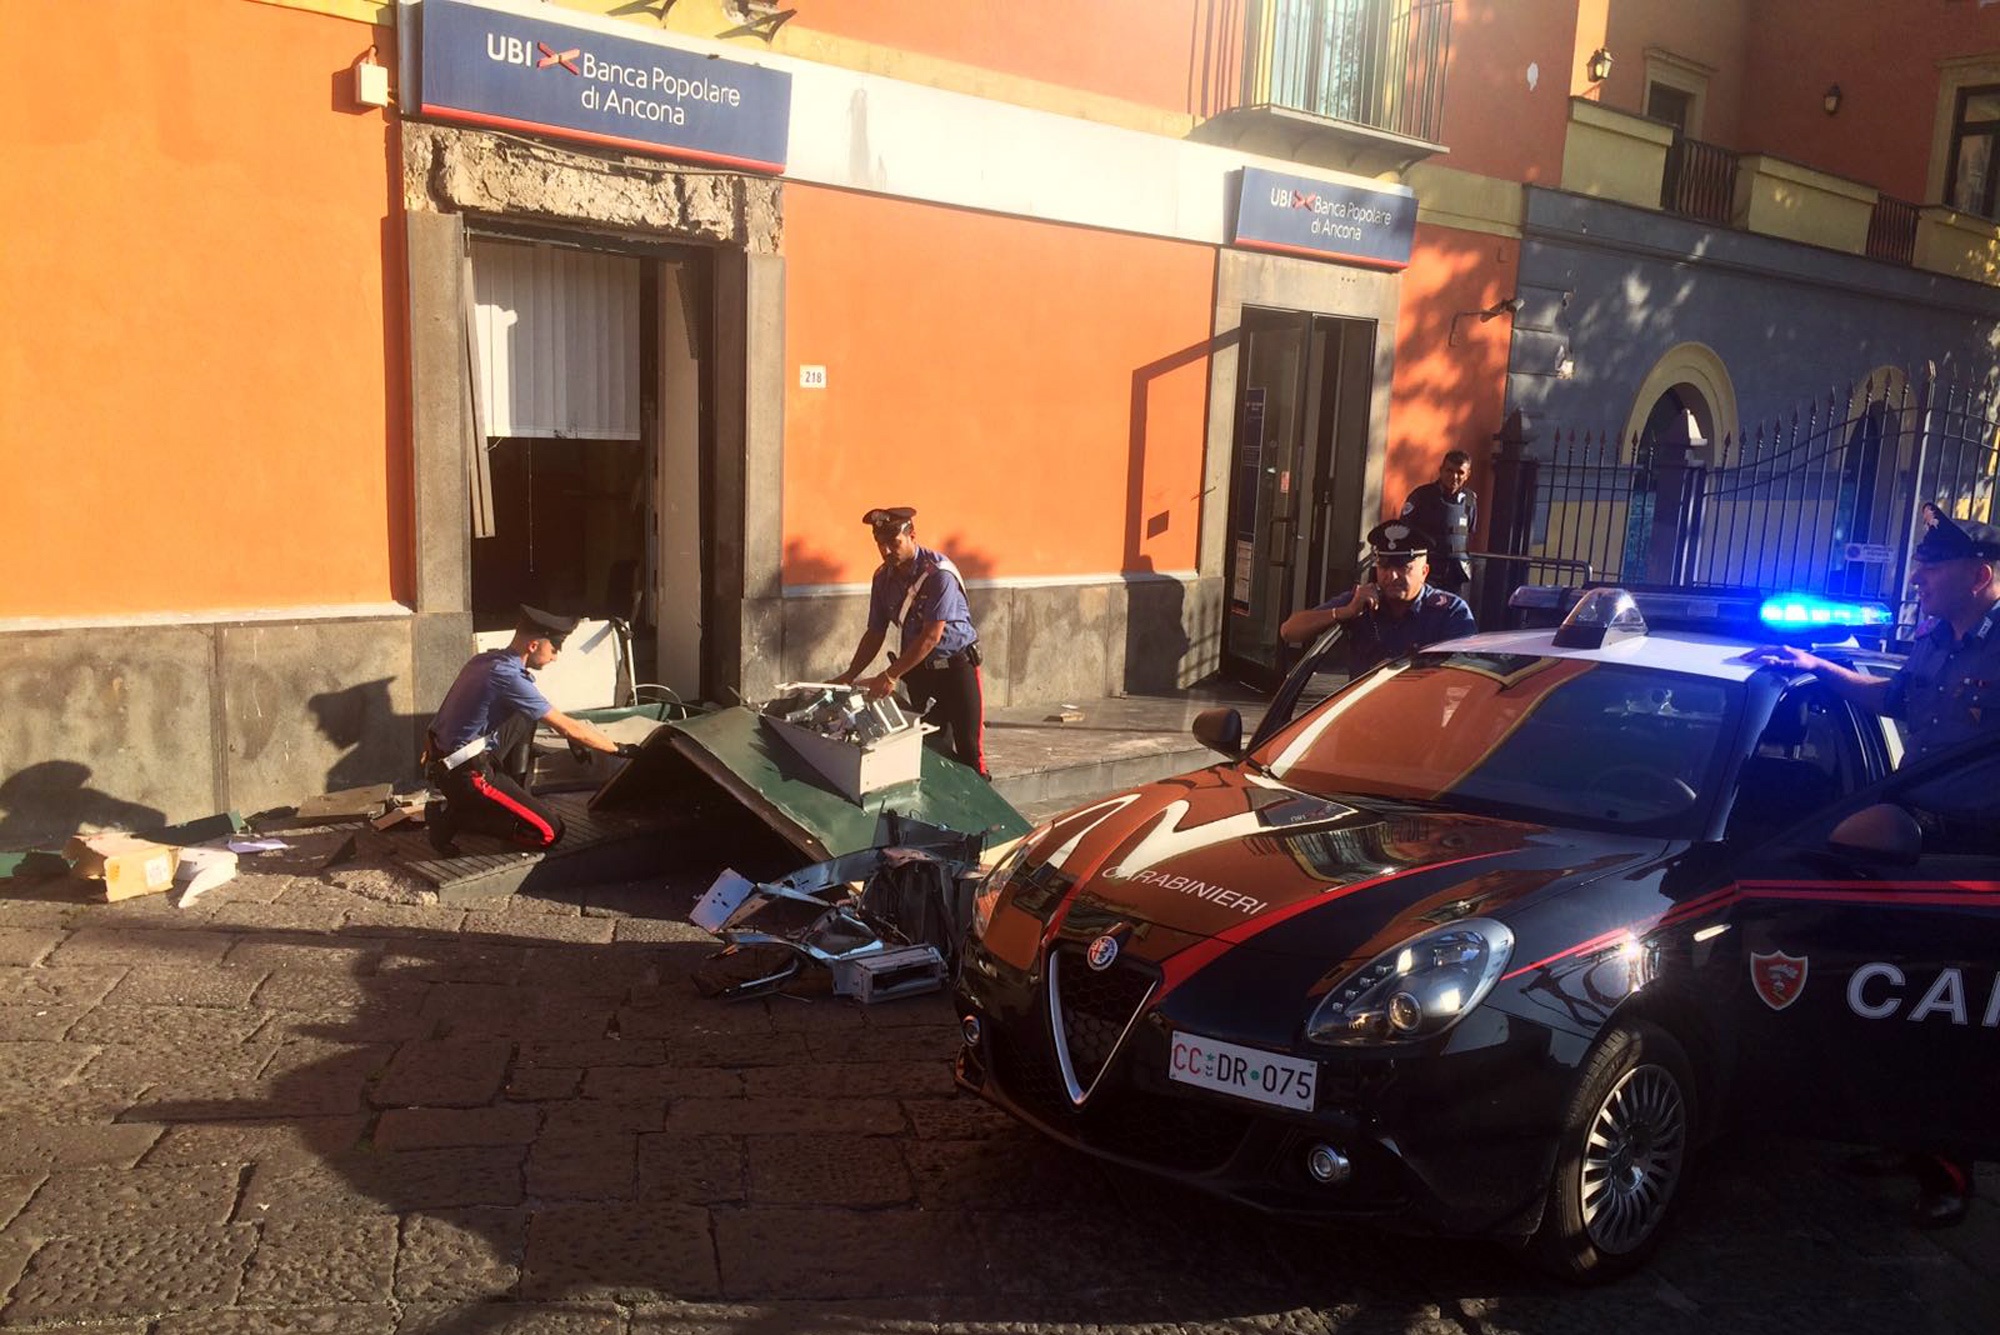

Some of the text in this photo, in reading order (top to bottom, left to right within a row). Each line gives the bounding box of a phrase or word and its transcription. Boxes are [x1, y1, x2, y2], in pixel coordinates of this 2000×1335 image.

[487, 33, 741, 107] UBI Banca Popolare
[581, 85, 685, 125] di Ancona
[1270, 187, 1392, 226] UBI Banca Popolare
[1311, 217, 1362, 241] di Ancona
[805, 371, 822, 384] 218
[1173, 1043, 1313, 1099] CC DR 075
